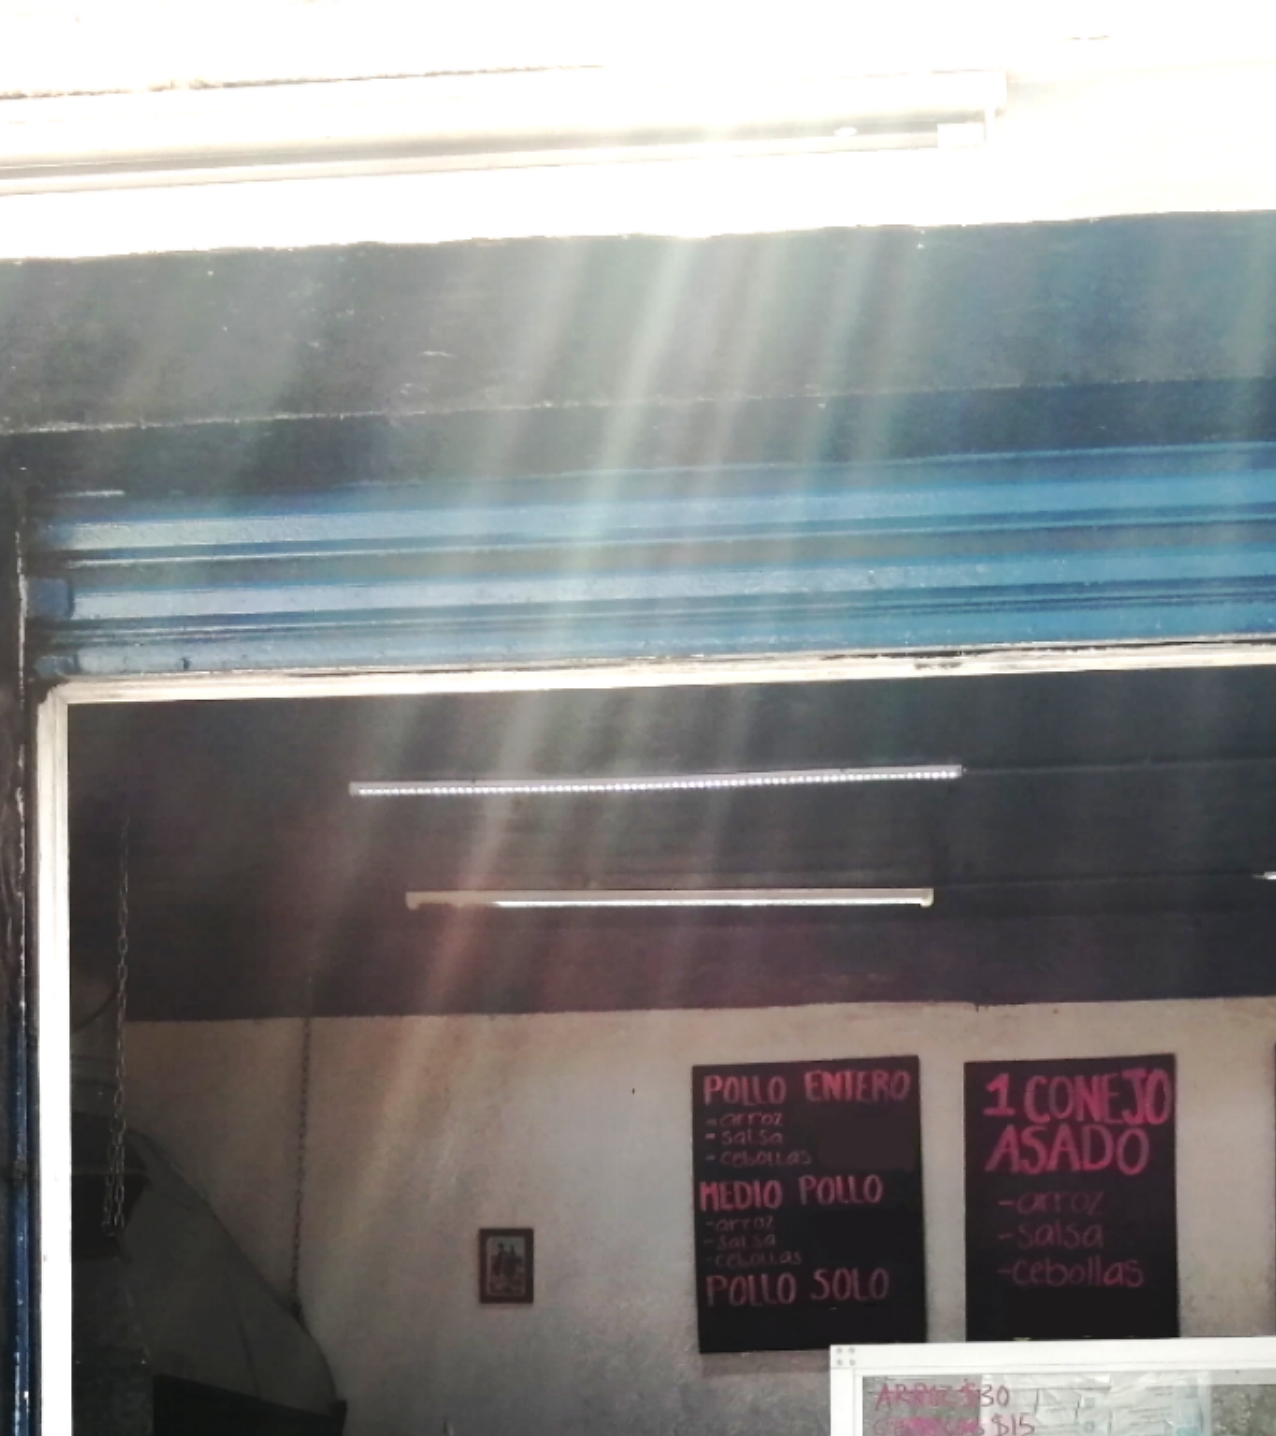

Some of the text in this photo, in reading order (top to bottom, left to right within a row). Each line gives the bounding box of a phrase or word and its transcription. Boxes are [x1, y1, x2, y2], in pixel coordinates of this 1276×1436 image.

[703, 1069, 911, 1105] POLLO ENTERO
[983, 1068, 1172, 1125] 1 CONEJO
[984, 1122, 1150, 1175] ASADO
[699, 1174, 884, 1211] MEDIO POLLO
[706, 1267, 889, 1307] POLLO SOLO
[959, 1378, 1011, 1408] $30
